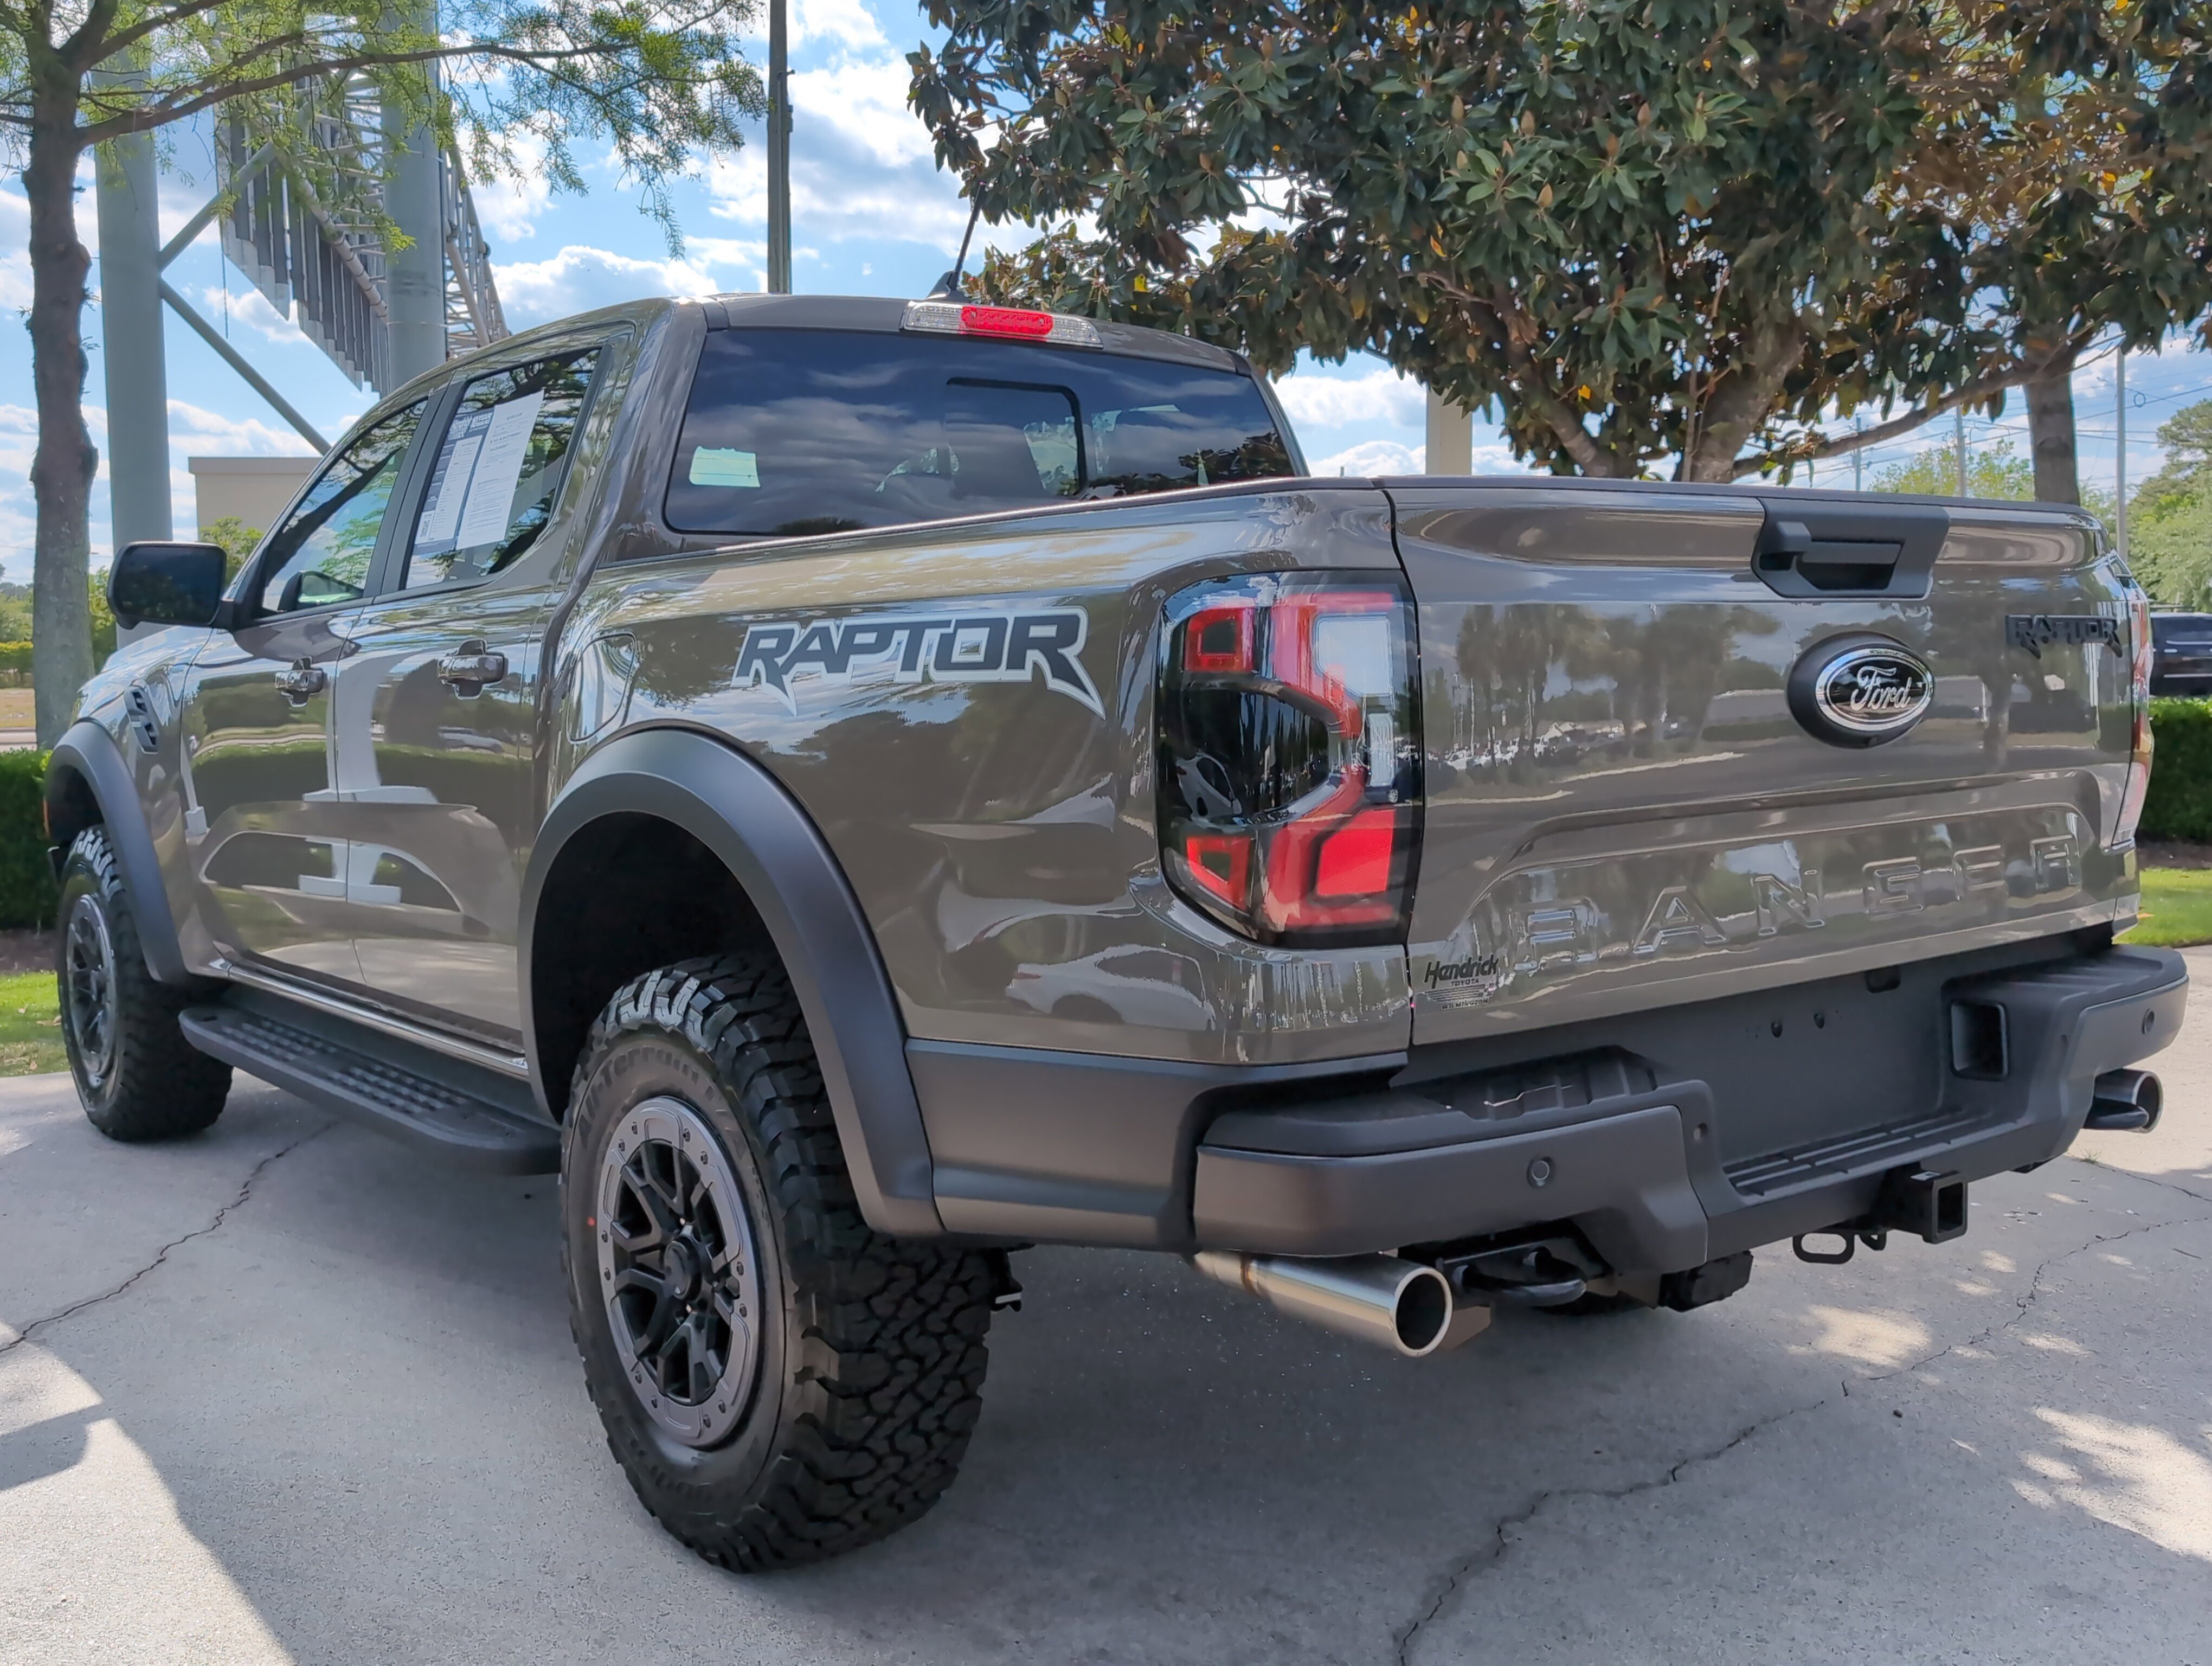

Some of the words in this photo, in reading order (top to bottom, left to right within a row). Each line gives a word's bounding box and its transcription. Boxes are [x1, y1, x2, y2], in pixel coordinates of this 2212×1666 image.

[2005, 614, 2123, 659] RAPTOR
[730, 606, 1107, 720] RAPTOR
[1850, 666, 1912, 712] Ford
[1509, 834, 2081, 972] RANGER
[1424, 953, 1499, 989] Hendrick
[1450, 978, 1480, 986] TOYOTA
